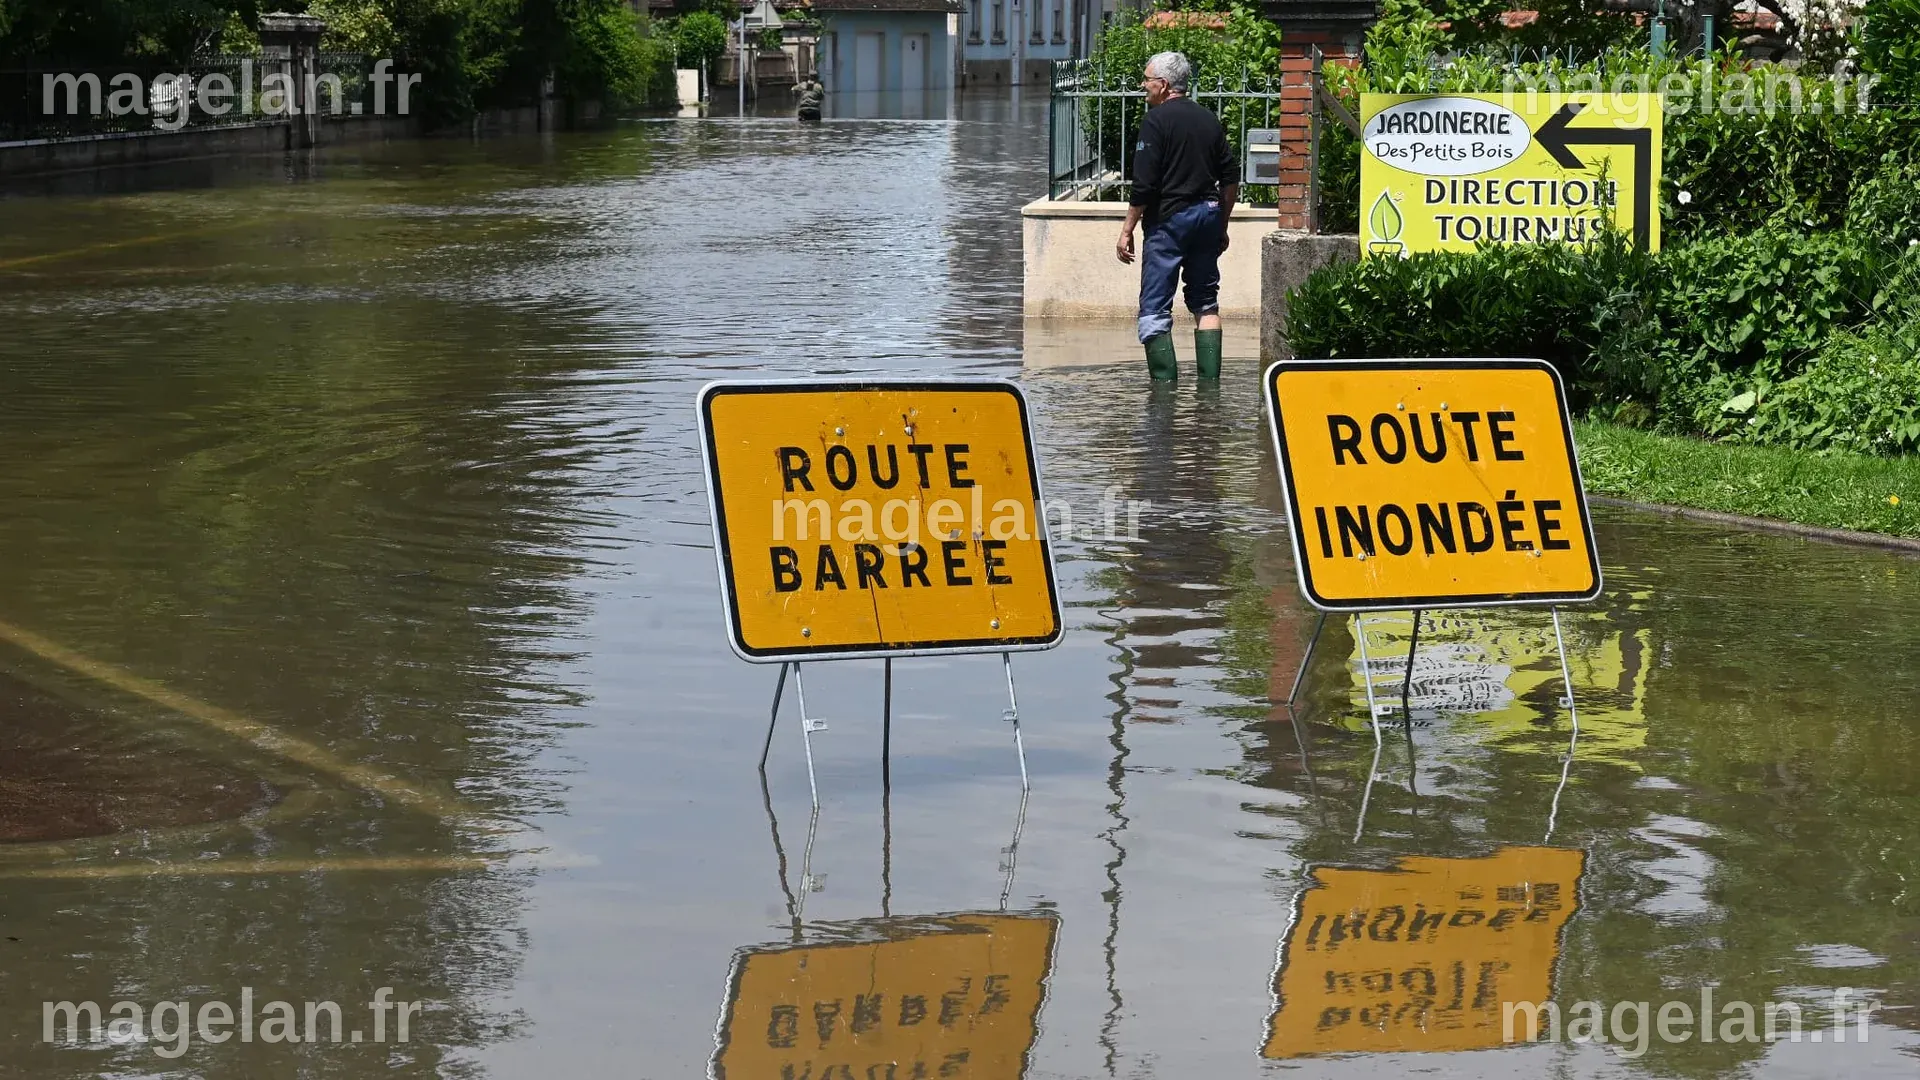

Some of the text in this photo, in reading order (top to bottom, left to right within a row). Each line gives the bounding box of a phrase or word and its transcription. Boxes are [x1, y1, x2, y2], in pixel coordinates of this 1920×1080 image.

[1376, 111, 1512, 135] JARDINERIE
[1376, 142, 1513, 162] Des Petits Bois
[1425, 179, 1617, 206] DIRECTION
[1326, 411, 1525, 465] ROUTE
[780, 443, 976, 492] ROUTE
[1314, 490, 1571, 558] INONDÉE
[769, 528, 1013, 593] BARRÉE
